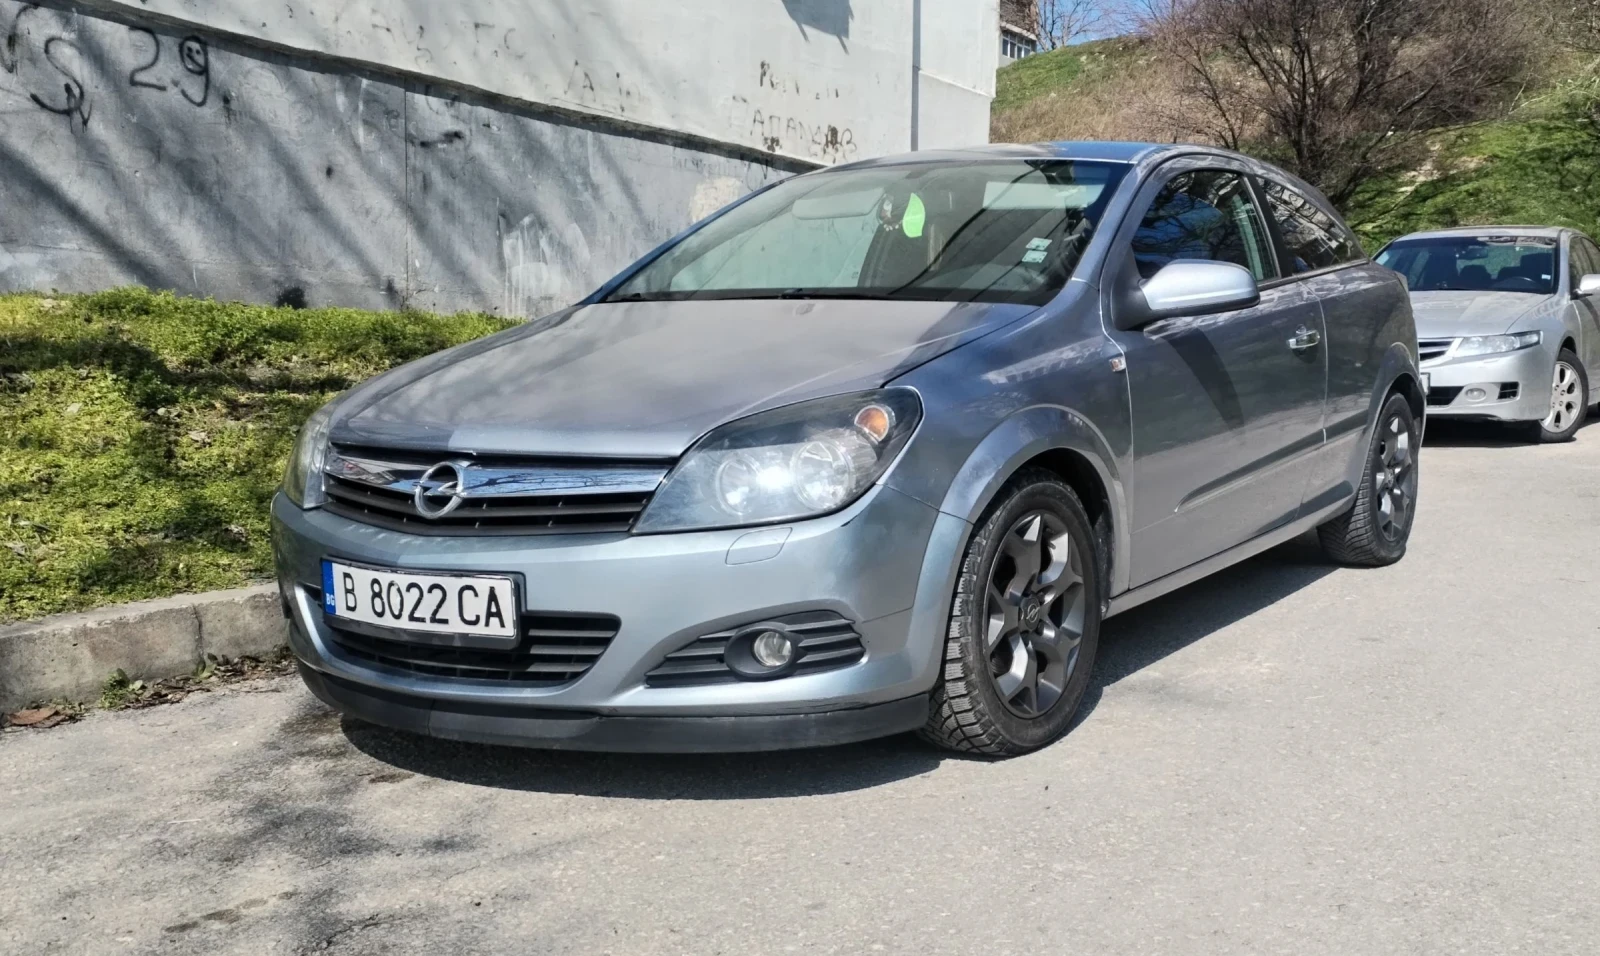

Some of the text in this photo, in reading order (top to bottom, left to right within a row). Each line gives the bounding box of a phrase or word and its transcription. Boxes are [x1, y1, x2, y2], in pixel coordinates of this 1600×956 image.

[326, 593, 335, 606] BG
[343, 572, 506, 628] B 8022 CA
